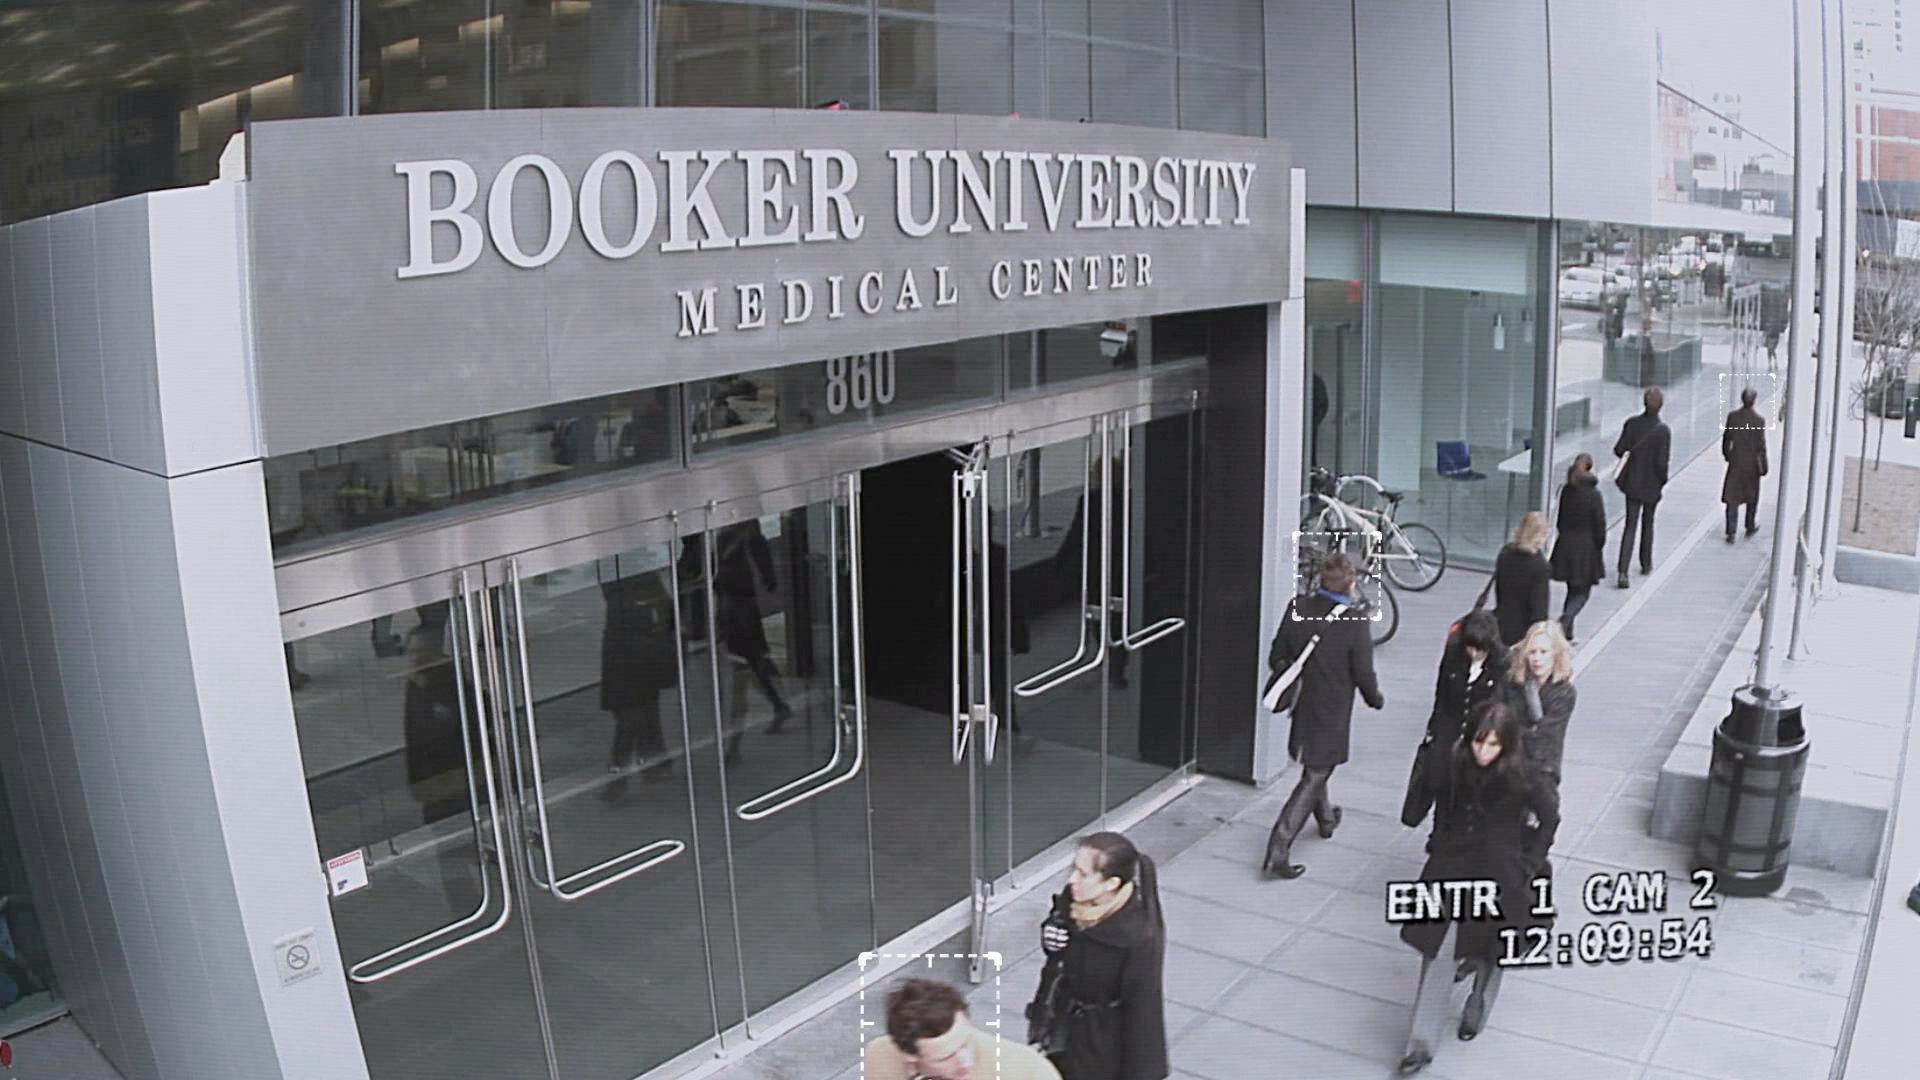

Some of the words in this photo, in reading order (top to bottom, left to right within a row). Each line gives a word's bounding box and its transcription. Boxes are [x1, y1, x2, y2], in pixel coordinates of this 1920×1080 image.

[394, 148, 865, 279] BOOKER
[888, 149, 1257, 237] UNIVERSITY
[677, 265, 958, 337] MEDICAL
[991, 252, 1153, 300] CENTER
[826, 350, 896, 415] 860
